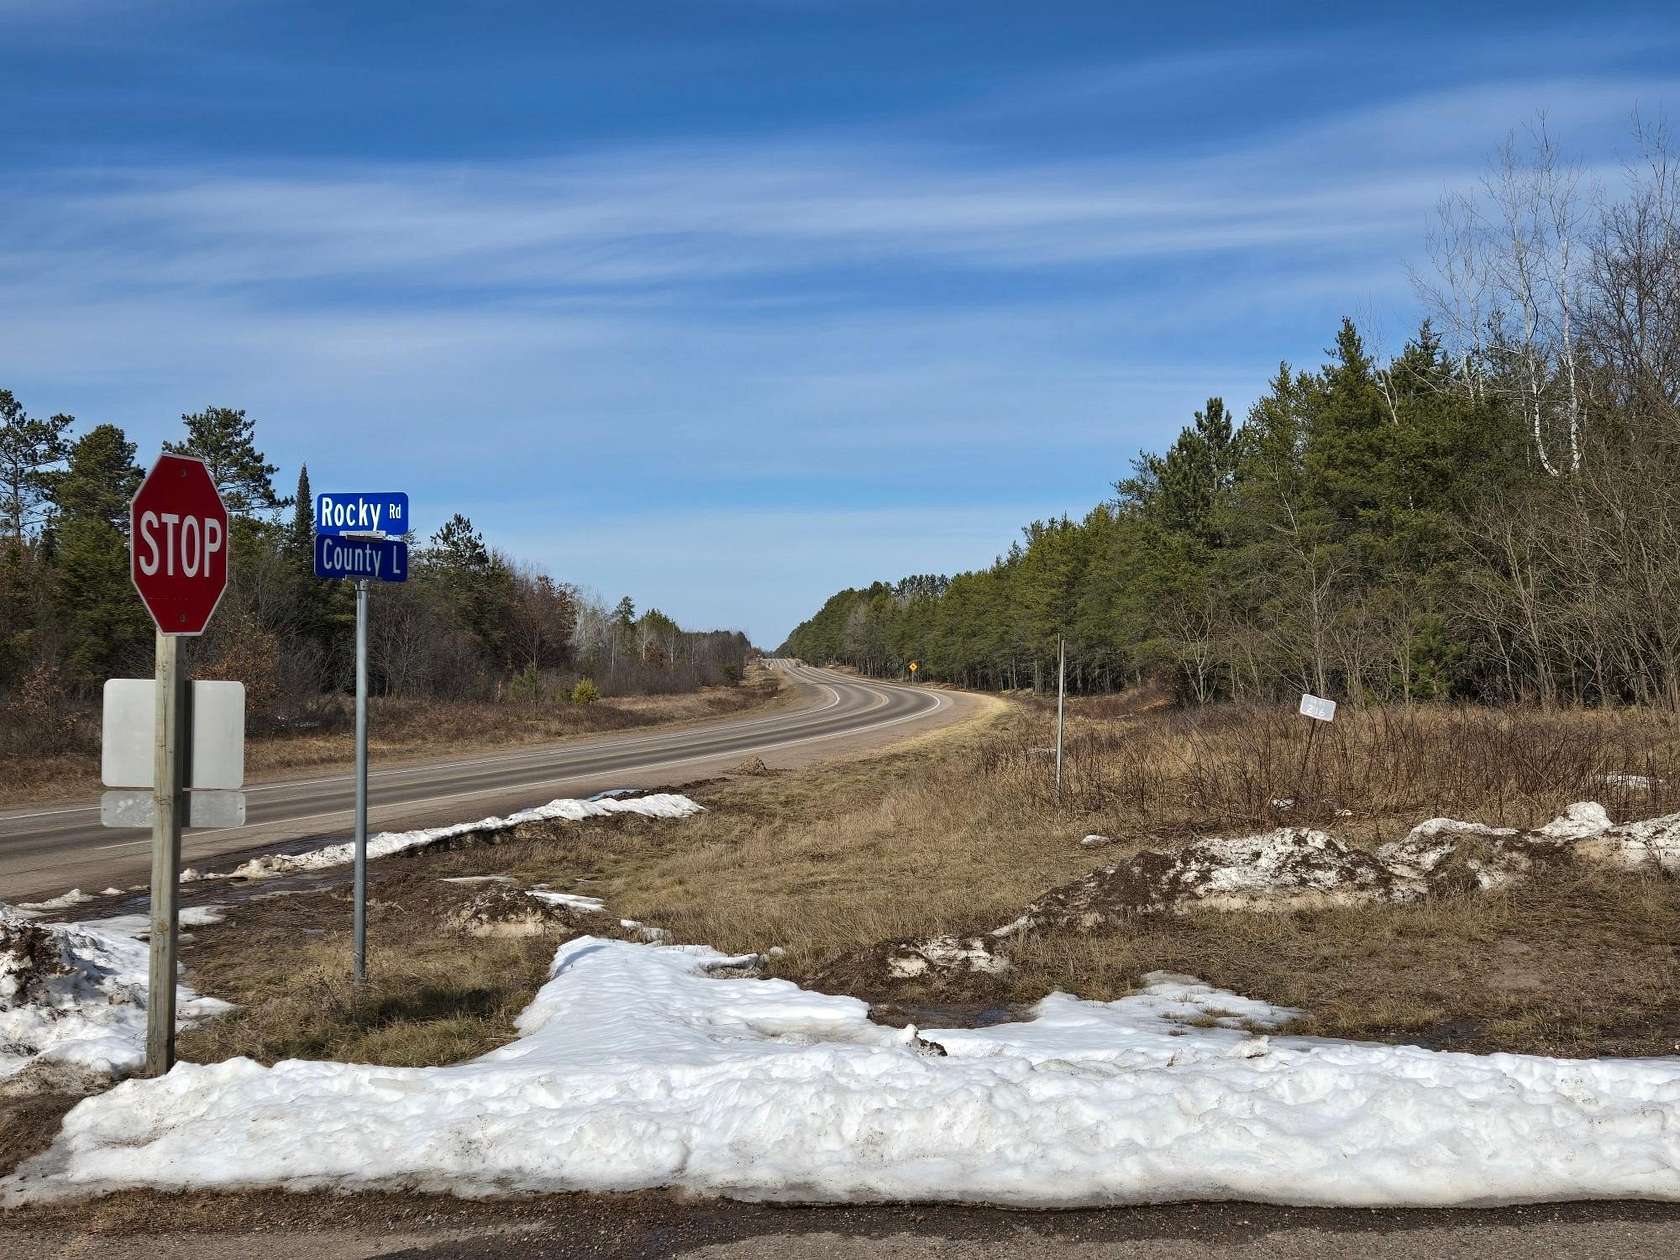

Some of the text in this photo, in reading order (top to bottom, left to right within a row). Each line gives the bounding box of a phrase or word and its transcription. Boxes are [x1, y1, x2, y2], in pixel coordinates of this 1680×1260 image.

[321, 497, 401, 531] Rocky Rd
[138, 510, 222, 578] STOP
[323, 538, 401, 577] County L
